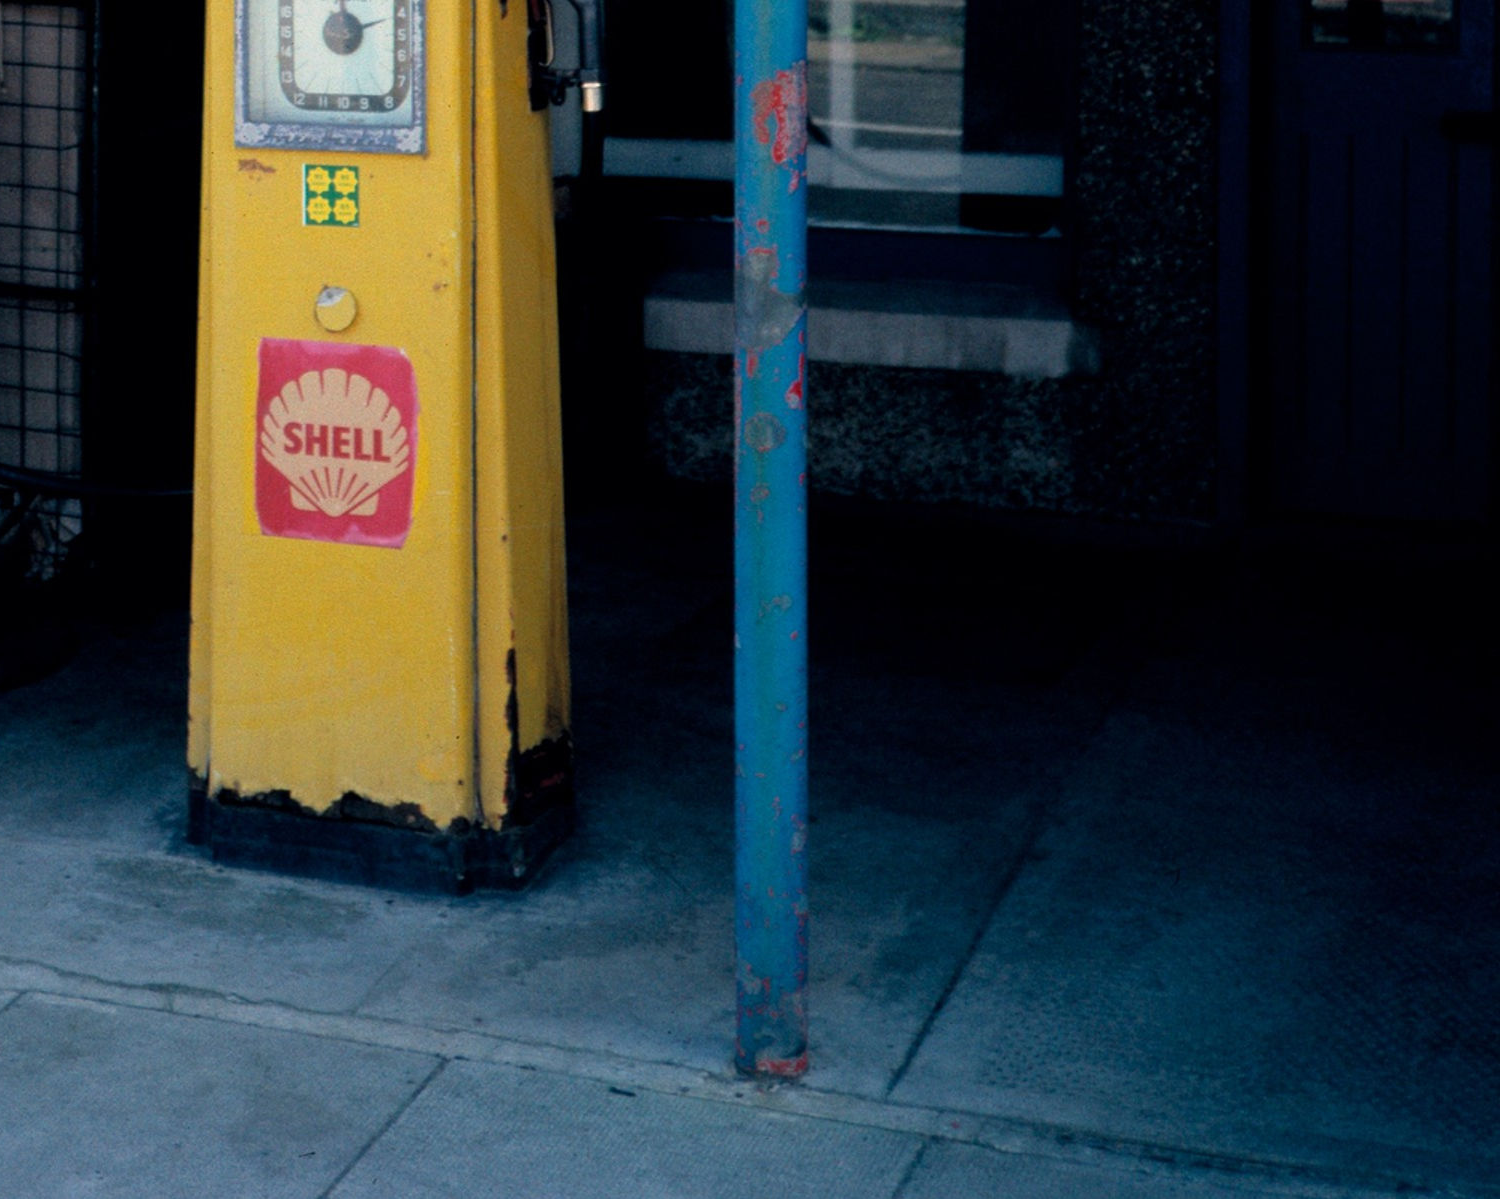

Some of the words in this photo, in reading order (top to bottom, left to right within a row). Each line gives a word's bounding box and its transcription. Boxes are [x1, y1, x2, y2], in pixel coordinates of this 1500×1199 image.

[397, 6, 407, 18] 4
[280, 26, 292, 38] 15
[397, 29, 406, 41] 5
[397, 49, 406, 61] 6
[281, 71, 293, 83] 13
[397, 75, 406, 88] 7
[293, 93, 305, 105] 12
[337, 97, 349, 109] 10
[360, 97, 369, 109] 9
[384, 96, 394, 108] 8
[283, 421, 391, 464] SHELL
